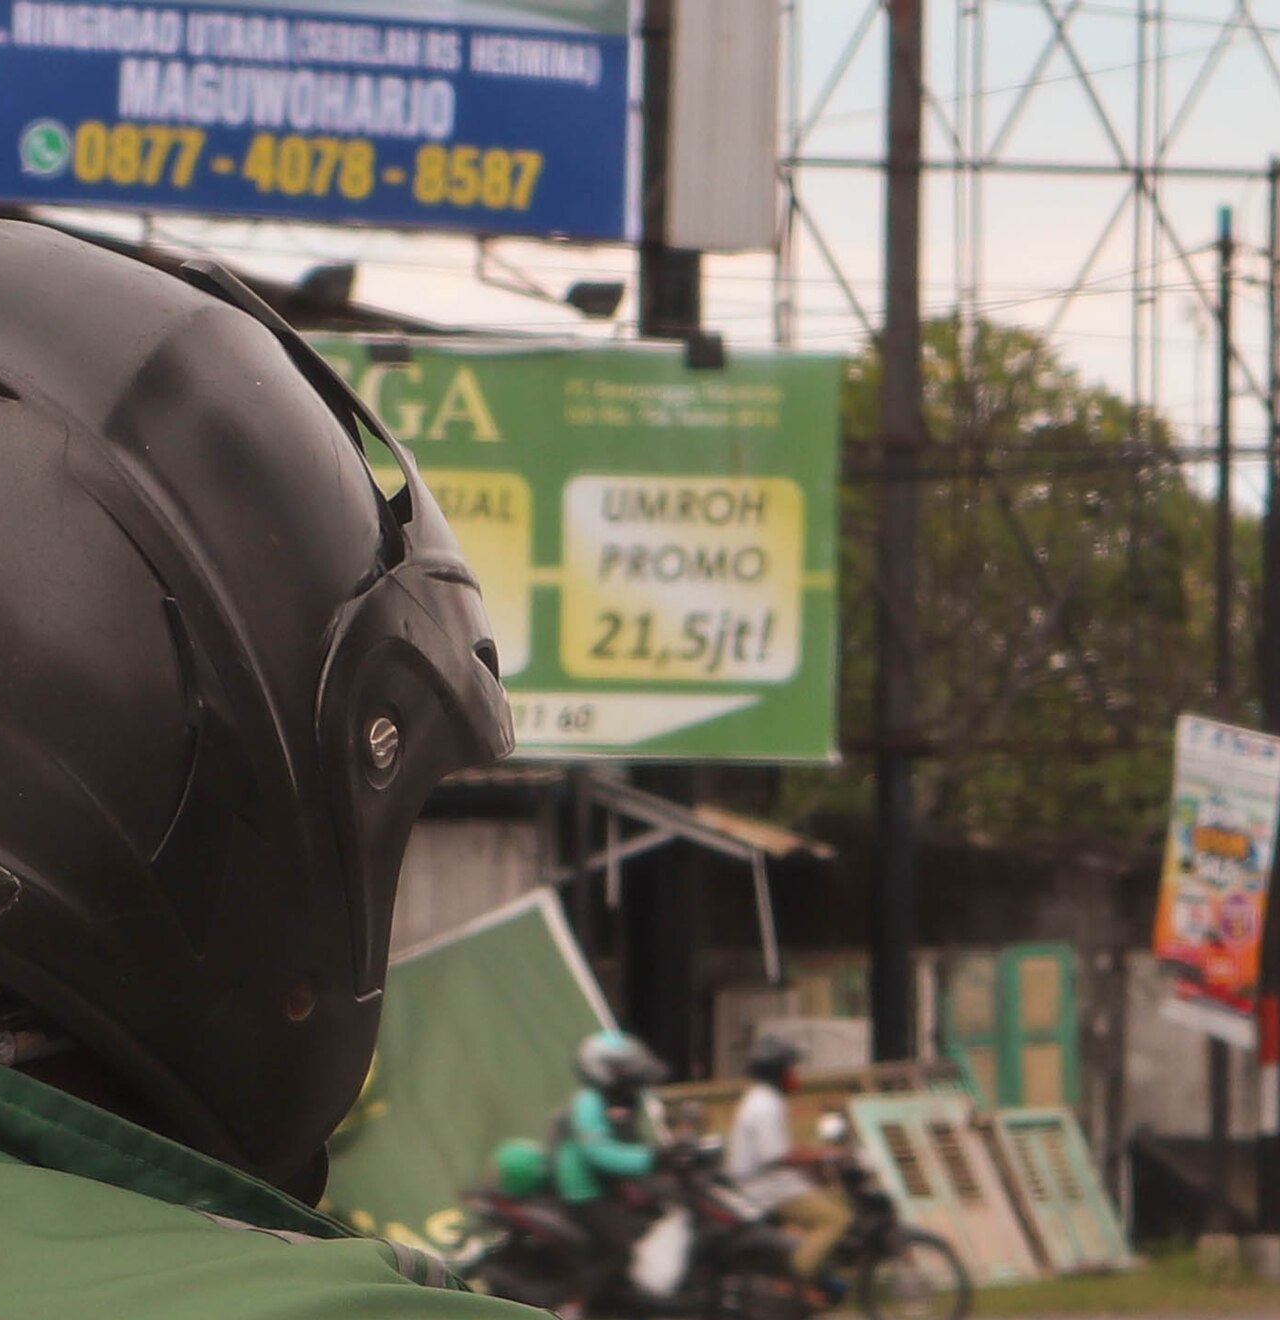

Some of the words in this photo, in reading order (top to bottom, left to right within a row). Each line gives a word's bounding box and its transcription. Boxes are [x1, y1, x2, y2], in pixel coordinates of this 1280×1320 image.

[12, 0, 180, 53] RINGROAD
[186, 11, 289, 62] UTARA
[119, 57, 455, 140] MAGUWOHARJO
[73, 120, 205, 188] 0877
[243, 132, 375, 199] 4078
[412, 142, 543, 211] 8587
[601, 485, 766, 524] UMROH
[599, 543, 765, 583] PROMO
[588, 608, 777, 673] 21,5jt!
